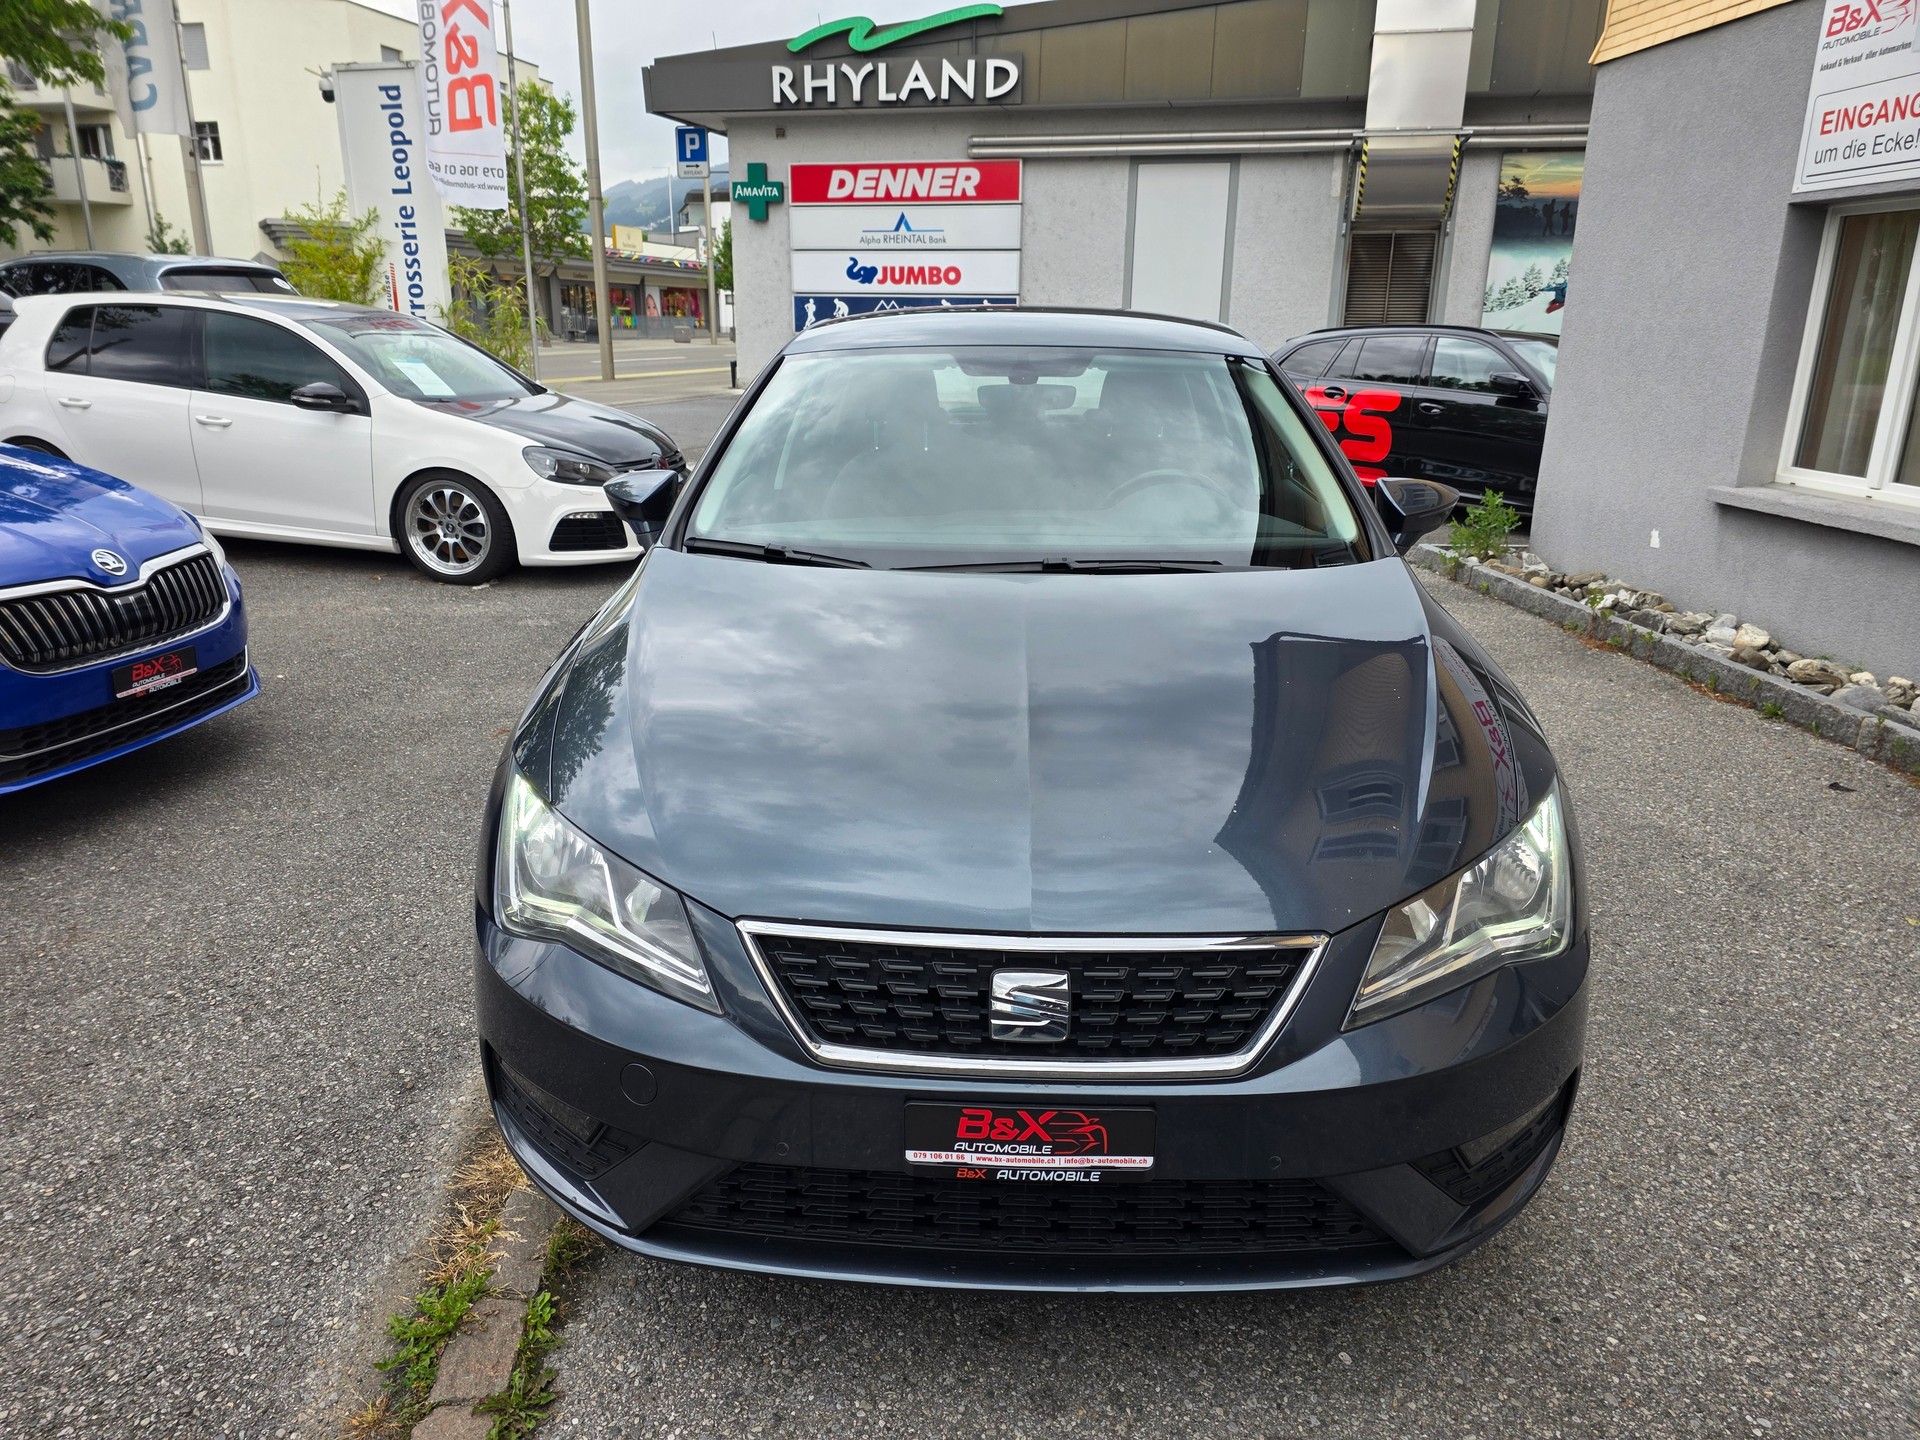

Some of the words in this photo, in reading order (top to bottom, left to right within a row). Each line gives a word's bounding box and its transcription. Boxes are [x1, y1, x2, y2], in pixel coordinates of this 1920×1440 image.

[1822, 27, 1881, 51] AUTOMOBILE
[1820, 60, 1838, 72] Ankauf
[1843, 53, 1863, 66] Verkauf
[1865, 50, 1878, 60] aller
[771, 58, 1019, 104] RHYLAND
[378, 84, 413, 195] Leopold
[685, 133, 700, 158] P
[1814, 146, 1838, 164] um
[1842, 138, 1867, 160] die
[827, 167, 981, 199] DENNER
[860, 235, 881, 246] Alpha
[883, 234, 927, 244] RHEINTAL
[928, 235, 947, 244] Bank
[877, 265, 962, 286] JUMBO
[132, 656, 165, 681] B&X
[957, 1108, 1058, 1142] B&X
[913, 1152, 928, 1160] 079
[930, 1152, 943, 1160] 106
[944, 1153, 954, 1161] 01
[955, 1153, 966, 1161] 66
[975, 1155, 1056, 1165] www.bx-automobile.ch
[1064, 1156, 1148, 1165] info@bx-automobile.ch
[954, 1141, 1053, 1155] AUTOMOBILE
[956, 1167, 988, 1179] B&X
[996, 1169, 1101, 1182] AUTOMOBILE
